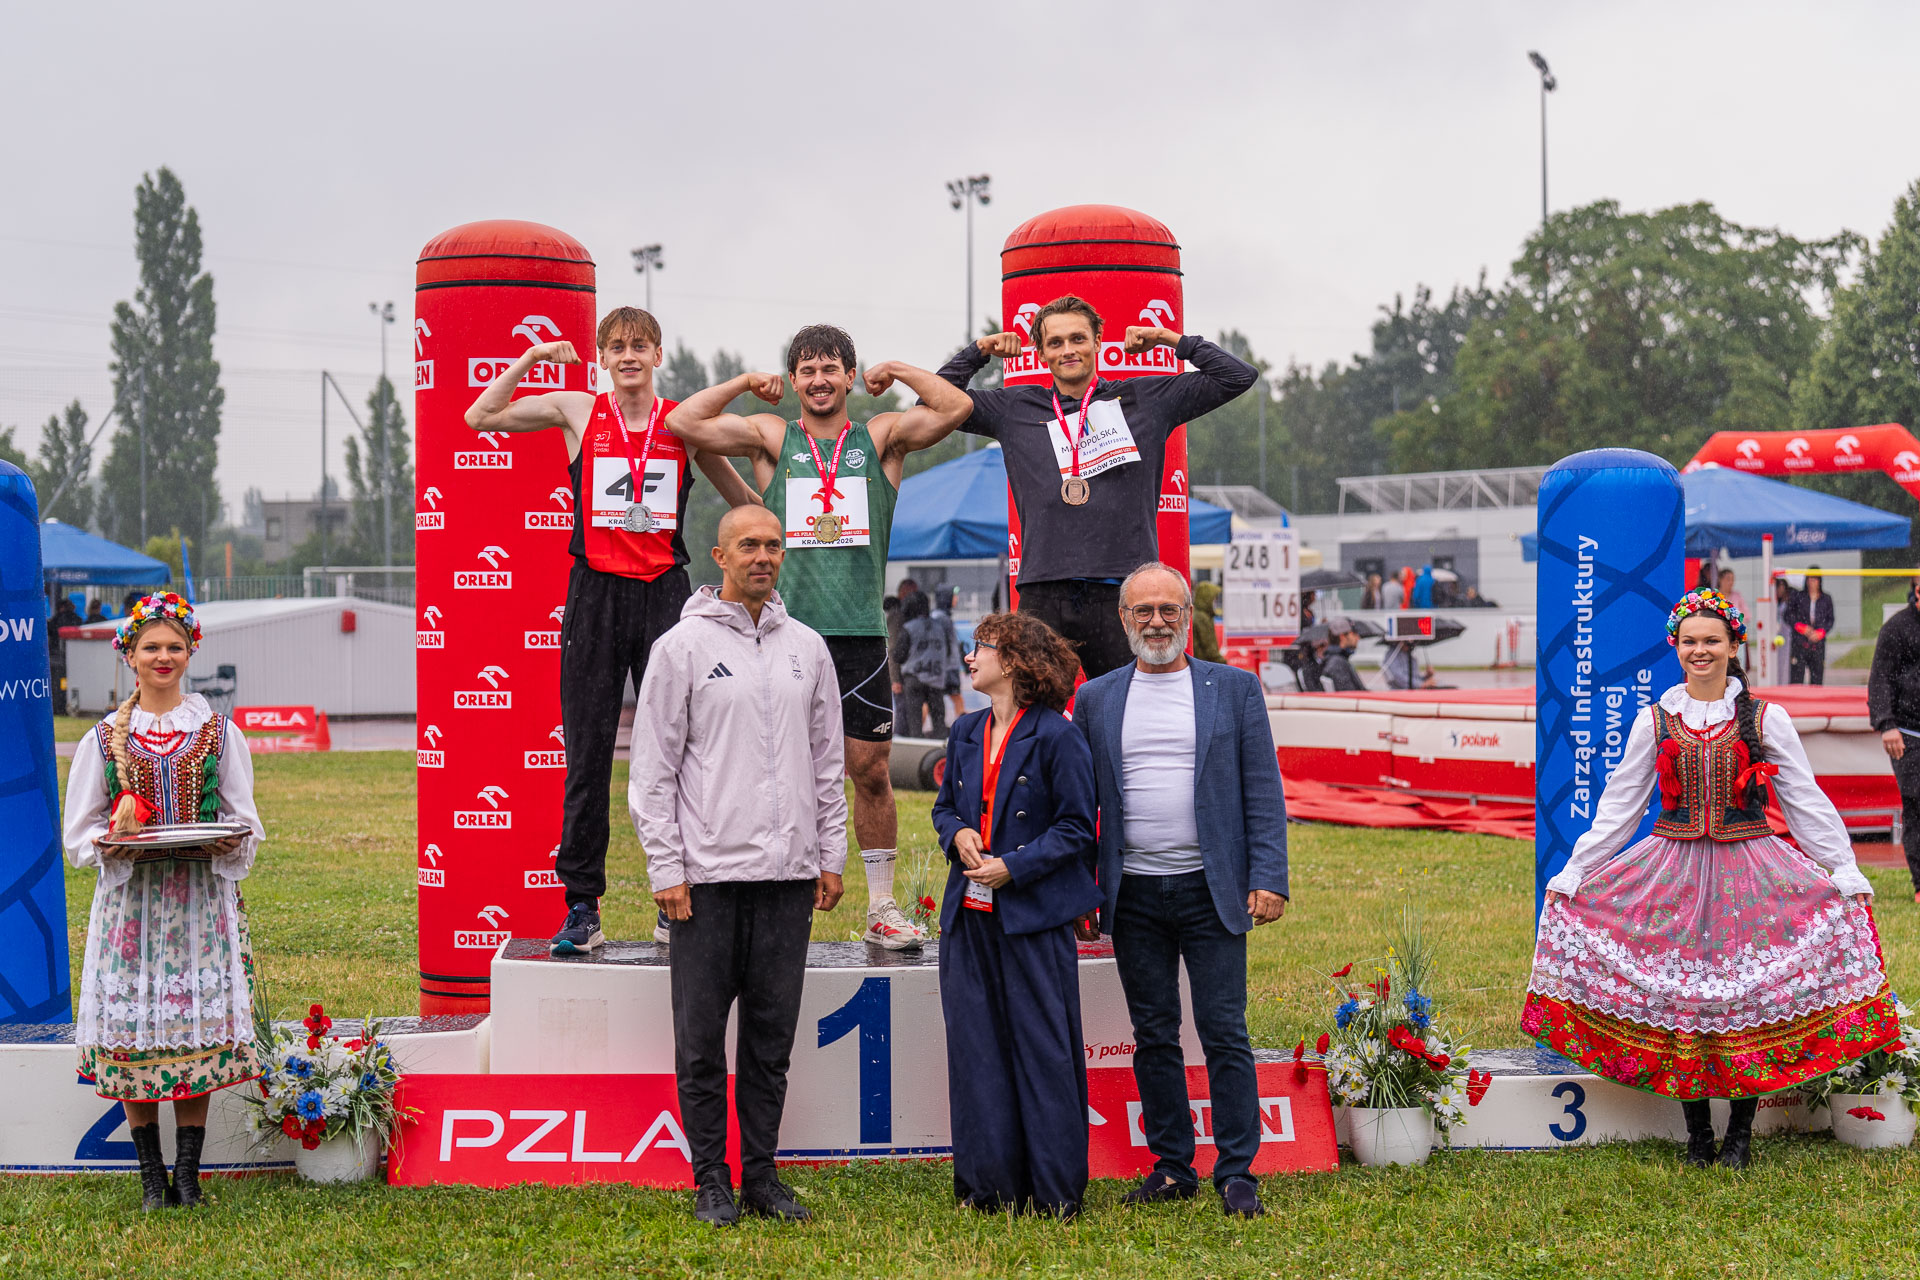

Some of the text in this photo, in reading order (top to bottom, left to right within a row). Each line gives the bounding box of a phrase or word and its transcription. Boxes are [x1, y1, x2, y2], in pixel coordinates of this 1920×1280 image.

[1104, 346, 1174, 368] ORLEN
[474, 362, 560, 385] OEN
[457, 454, 508, 466] ORLEN
[792, 452, 812, 464] 4F
[1108, 456, 1126, 465] 2026
[606, 472, 666, 502] 4F
[1158, 496, 1186, 510] ORLEN
[416, 514, 442, 528] ORLEN
[528, 514, 574, 527] ORLEN
[1230, 545, 1270, 570] 248
[457, 574, 508, 586] ORLEN
[417, 634, 442, 646] ORLEN
[528, 634, 562, 646] ORL
[1570, 534, 1598, 819] Zarząd Infrastruktury
[457, 694, 508, 706] ORLEN
[245, 712, 307, 726] PZLA
[872, 721, 892, 734] 4F
[1600, 686, 1628, 783] rtowej
[417, 753, 442, 766] ORLEN
[528, 753, 567, 766] ORLE
[457, 814, 508, 826] ORLEN
[418, 872, 442, 884] ORLEN
[528, 873, 562, 885] ORL
[458, 934, 508, 946] ORLEN
[818, 976, 892, 1144] 1
[1757, 1093, 1804, 1112] polanik
[1548, 1081, 1588, 1142] 3
[439, 1109, 692, 1163] PZLA
